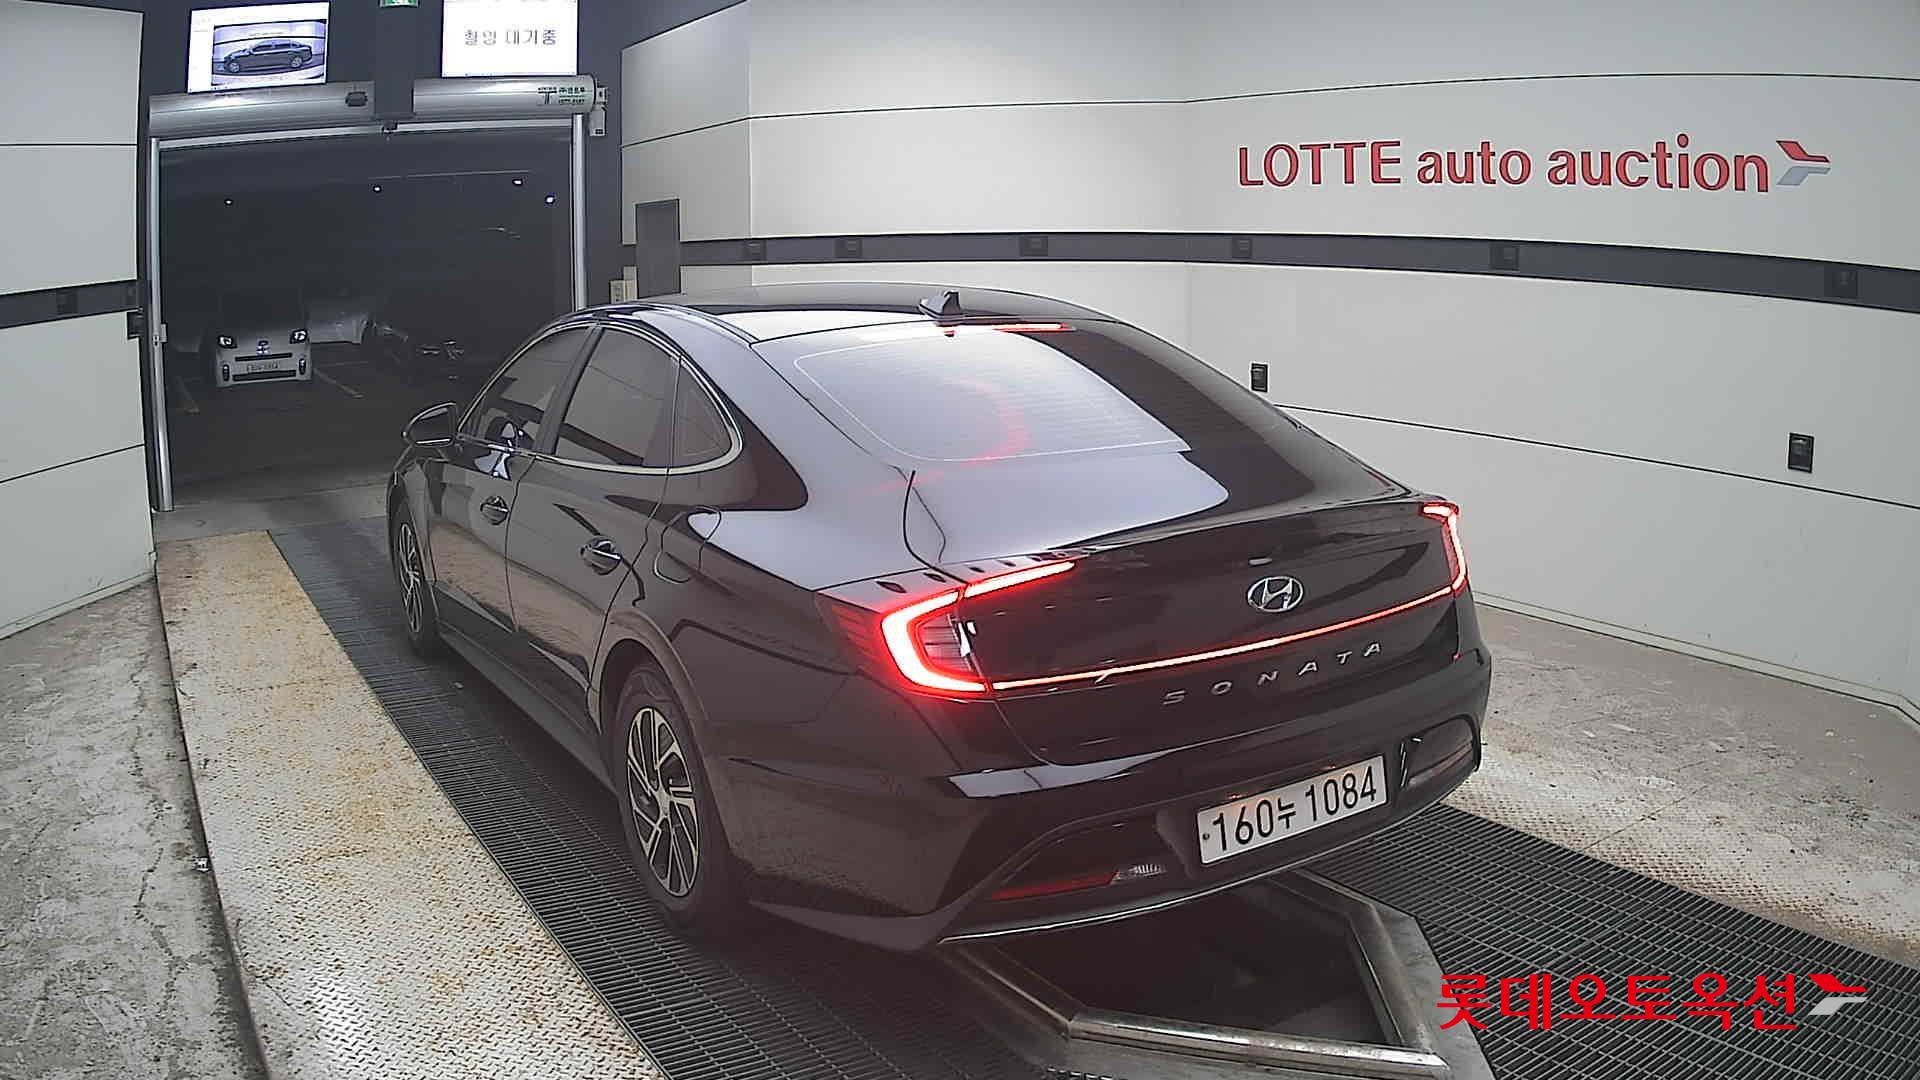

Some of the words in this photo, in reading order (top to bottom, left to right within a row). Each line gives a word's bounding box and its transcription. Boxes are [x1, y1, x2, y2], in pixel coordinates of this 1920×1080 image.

[1239, 140, 1401, 187] LOTTE
[1416, 141, 1532, 187] auto
[1547, 133, 1769, 194] auction
[1161, 641, 1382, 706] SONATA
